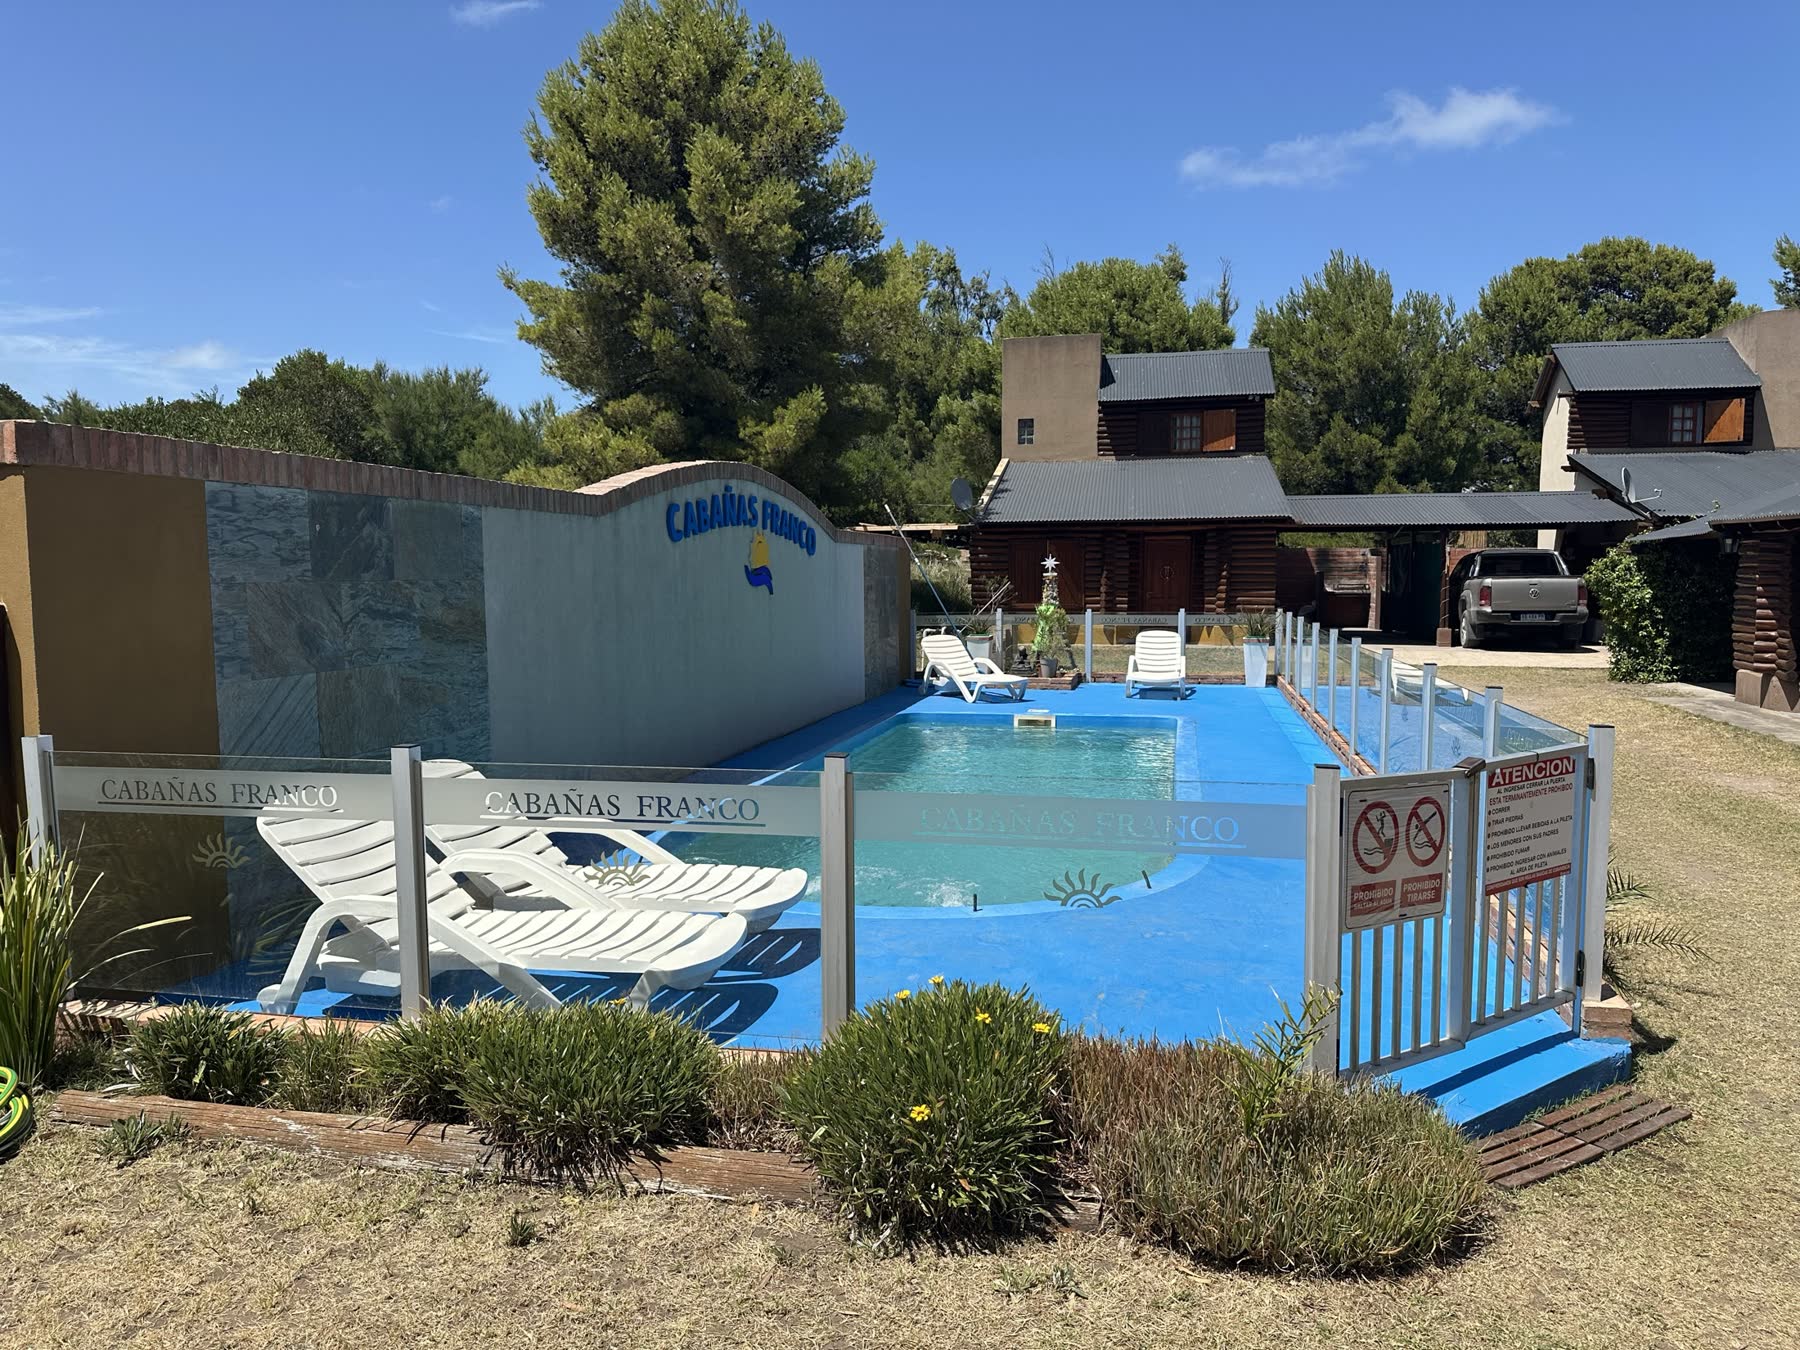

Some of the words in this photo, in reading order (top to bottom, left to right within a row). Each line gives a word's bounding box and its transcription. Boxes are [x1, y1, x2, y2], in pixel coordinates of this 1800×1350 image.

[666, 485, 758, 542] CABAÑAS
[762, 500, 816, 556] FRANCO
[1492, 758, 1574, 786] ATENCION
[101, 776, 217, 804] CABAÑAS
[231, 782, 338, 807] FRANCO
[1490, 797, 1502, 806] ESTA
[1503, 788, 1548, 802] TERMINANTEMENTE
[1548, 783, 1573, 793] PROHIBIDO
[1504, 784, 1526, 793] INGRESAR
[1526, 780, 1543, 789] CERRAR
[485, 788, 620, 817] CABAÑAS
[636, 795, 760, 821] FRANCO
[1492, 806, 1510, 814] CORRER
[920, 804, 1076, 836] CABAÑAS
[1096, 812, 1239, 842] FRANCO
[1492, 818, 1504, 826] TIRAR
[1506, 814, 1524, 822] PIEDRAS
[1492, 828, 1515, 837] PROHIBIDO
[1516, 824, 1531, 832] LLEVAR
[1532, 820, 1549, 828] BEBIDAS
[1500, 837, 1522, 846] MENORES
[1542, 829, 1558, 837] PADRES
[1490, 850, 1514, 860] PROHIBIDO
[1515, 846, 1530, 854] FUMAR
[1490, 861, 1514, 871] PROHIBIDO
[1515, 856, 1536, 866] INGRESAR
[1547, 848, 1566, 858] ANIMALES
[1354, 888, 1394, 900] PROHIBIDO
[1403, 879, 1440, 892] PROHIBIDO
[1406, 890, 1436, 902] TIRARSE
